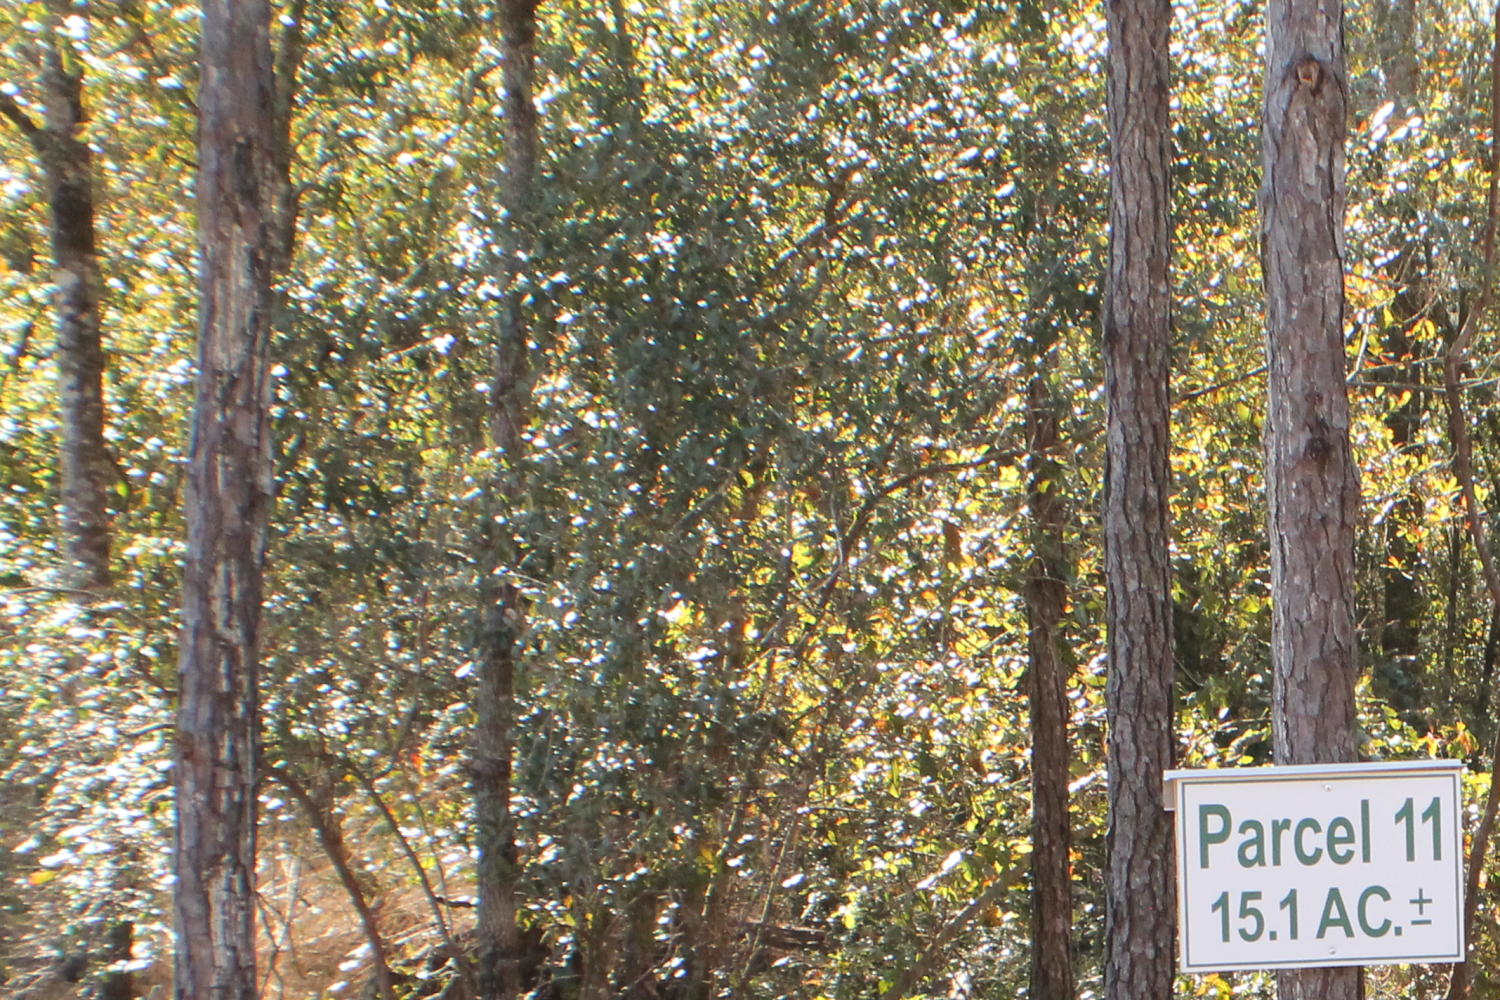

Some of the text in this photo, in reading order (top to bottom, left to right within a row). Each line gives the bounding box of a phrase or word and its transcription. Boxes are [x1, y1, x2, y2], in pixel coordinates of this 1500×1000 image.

[1198, 796, 1443, 869] Parcel 11
[1210, 888, 1299, 943] 15.1
